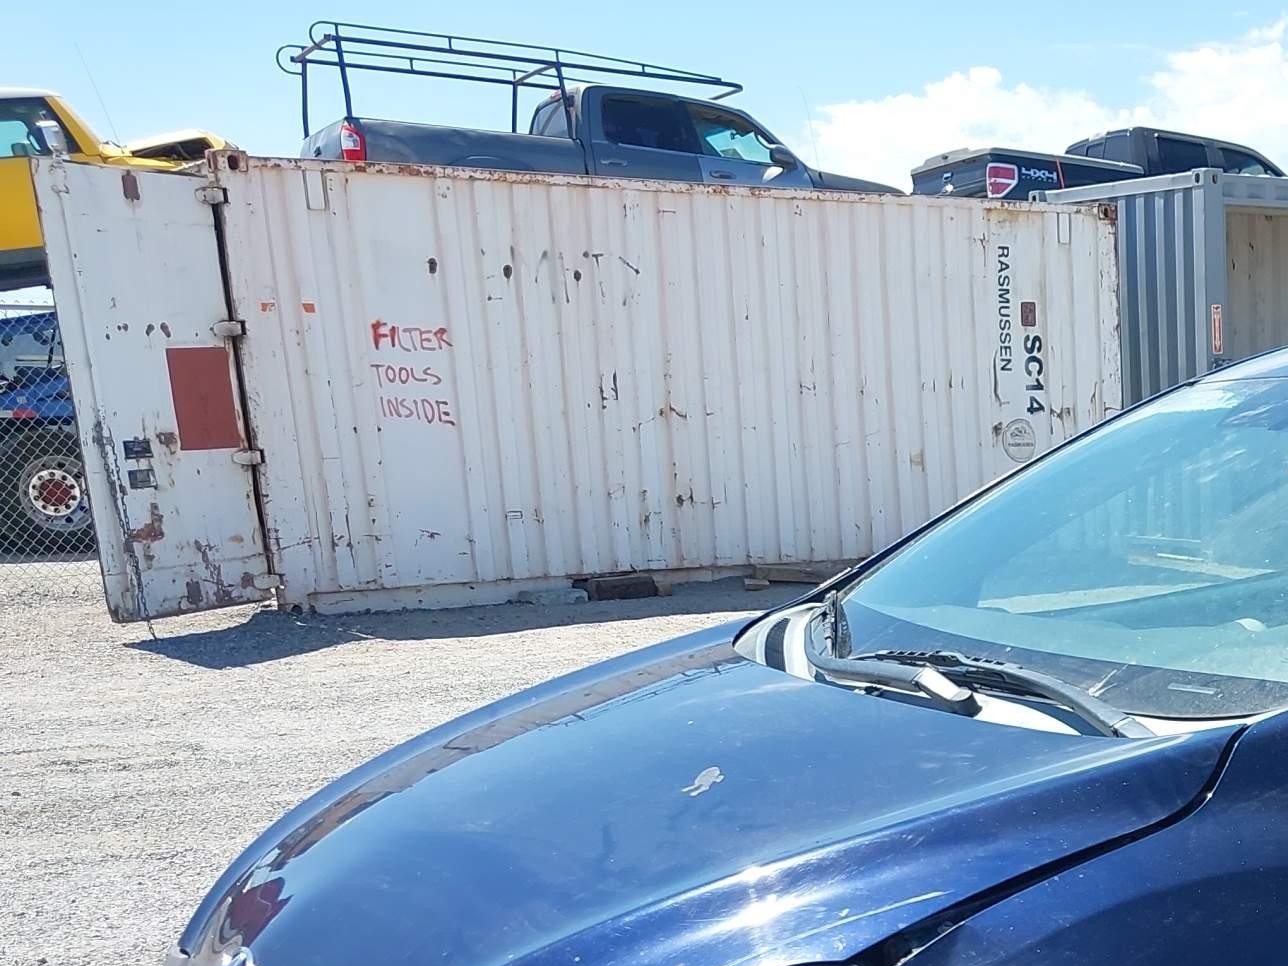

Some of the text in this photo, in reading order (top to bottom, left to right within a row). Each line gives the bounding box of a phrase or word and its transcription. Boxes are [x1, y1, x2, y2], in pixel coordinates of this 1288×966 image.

[998, 245, 1013, 372] RASMUSSEN
[371, 320, 453, 352] FILTER
[370, 364, 442, 388] TOOLS
[1023, 334, 1046, 415] SC14
[380, 396, 456, 426] INSIDE
